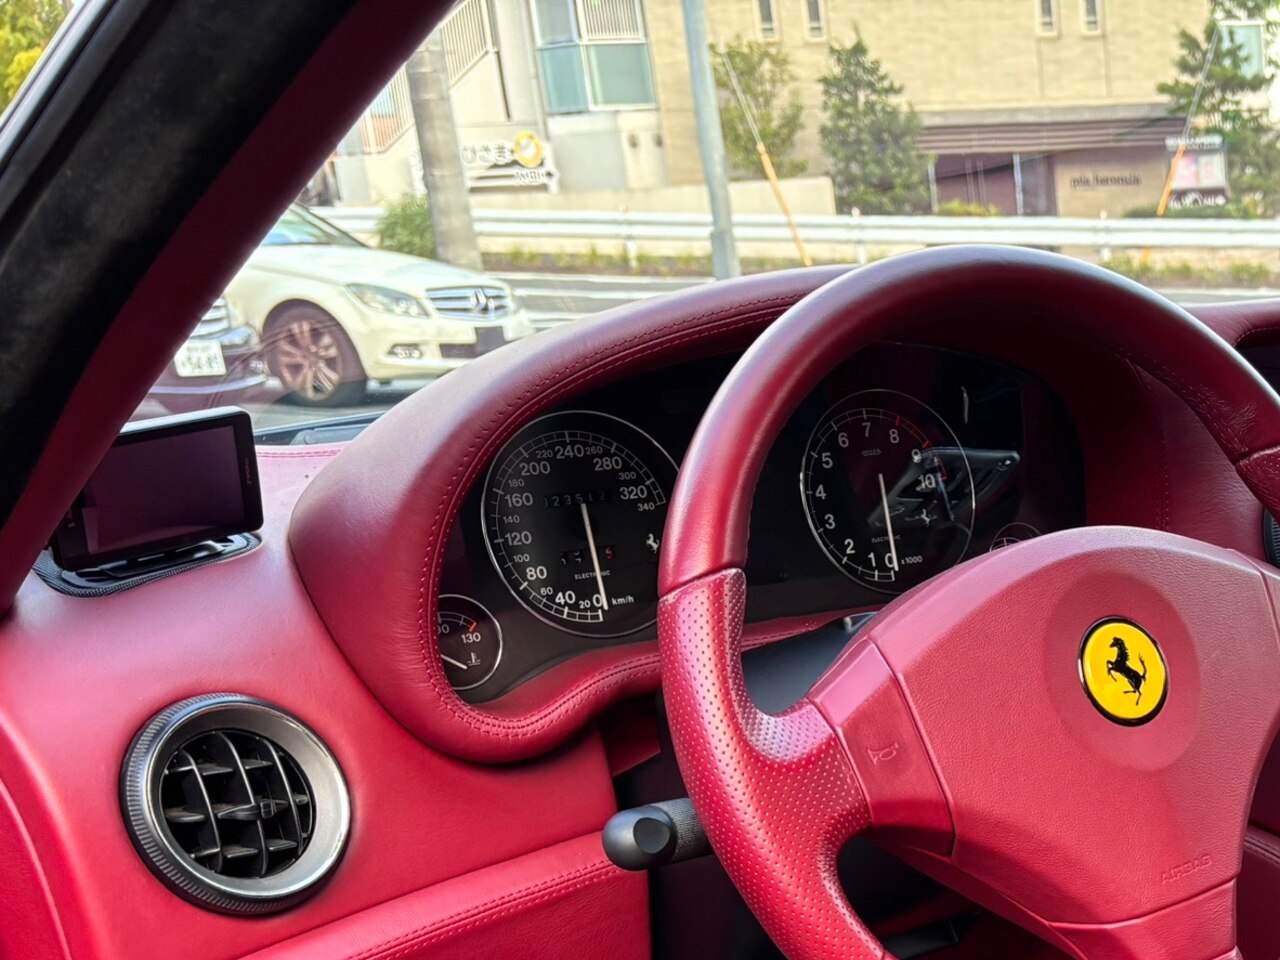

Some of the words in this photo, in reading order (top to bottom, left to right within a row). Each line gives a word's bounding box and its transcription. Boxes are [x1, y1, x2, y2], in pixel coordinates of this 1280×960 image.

[862, 422, 872, 438] 7
[889, 429, 900, 444] 8
[838, 432, 849, 448] 6
[536, 449, 554, 459] 220
[554, 444, 585, 459] 240
[585, 446, 603, 456] 260
[911, 449, 922, 464] 9
[593, 456, 622, 471] 280
[821, 452, 833, 469] 5
[519, 461, 551, 476] 200
[619, 471, 637, 481] 300
[508, 478, 525, 488] 180
[918, 474, 936, 489] 10
[620, 485, 648, 500] 320
[815, 484, 827, 500] 4
[505, 492, 534, 508] 160
[637, 502, 655, 512] 340
[503, 514, 520, 524] 140
[824, 514, 836, 530] 3
[505, 531, 532, 547] 120
[844, 539, 855, 555] 2
[513, 553, 530, 563] 100
[867, 552, 876, 567] 1
[884, 552, 896, 568] 0
[526, 566, 547, 580] 80
[540, 587, 553, 597] 60
[555, 590, 576, 605] 40
[579, 599, 591, 609] 20
[592, 594, 603, 607] 0
[611, 595, 635, 606] km/h
[461, 632, 481, 644] 130
